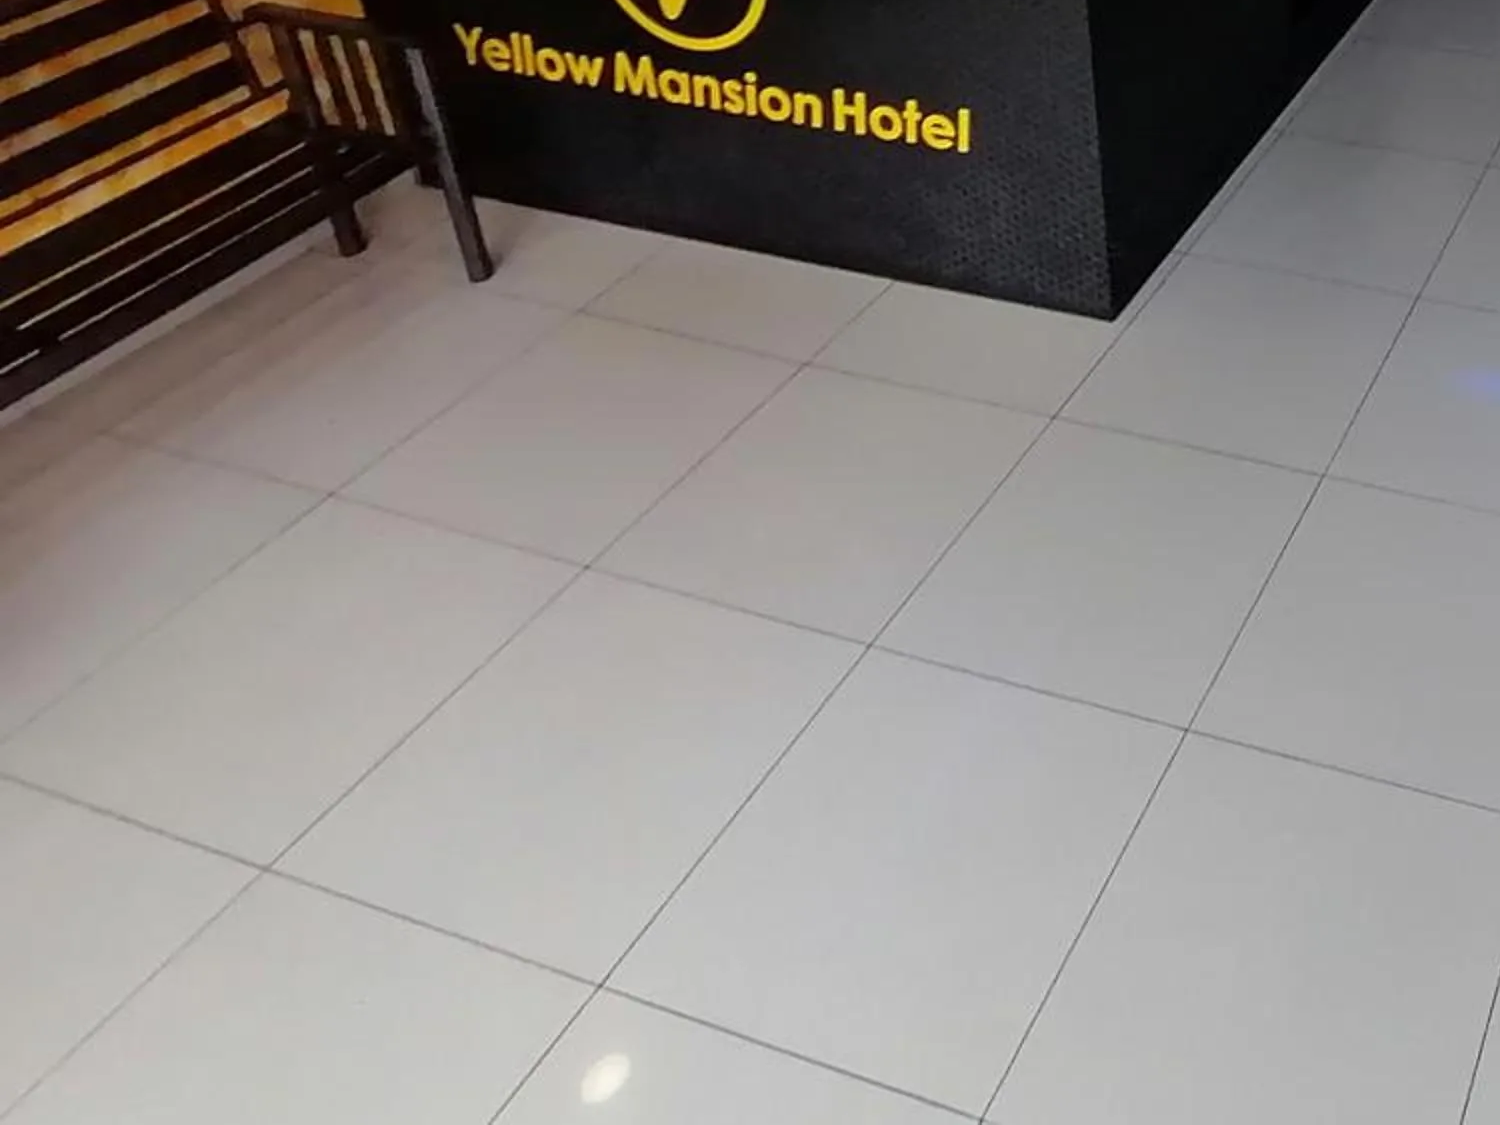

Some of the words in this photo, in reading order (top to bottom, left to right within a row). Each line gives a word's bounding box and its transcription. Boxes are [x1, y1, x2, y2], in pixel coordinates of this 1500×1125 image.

[453, 22, 603, 88] Yellow
[613, 50, 822, 129] Mansion
[832, 87, 971, 154] Hotel
